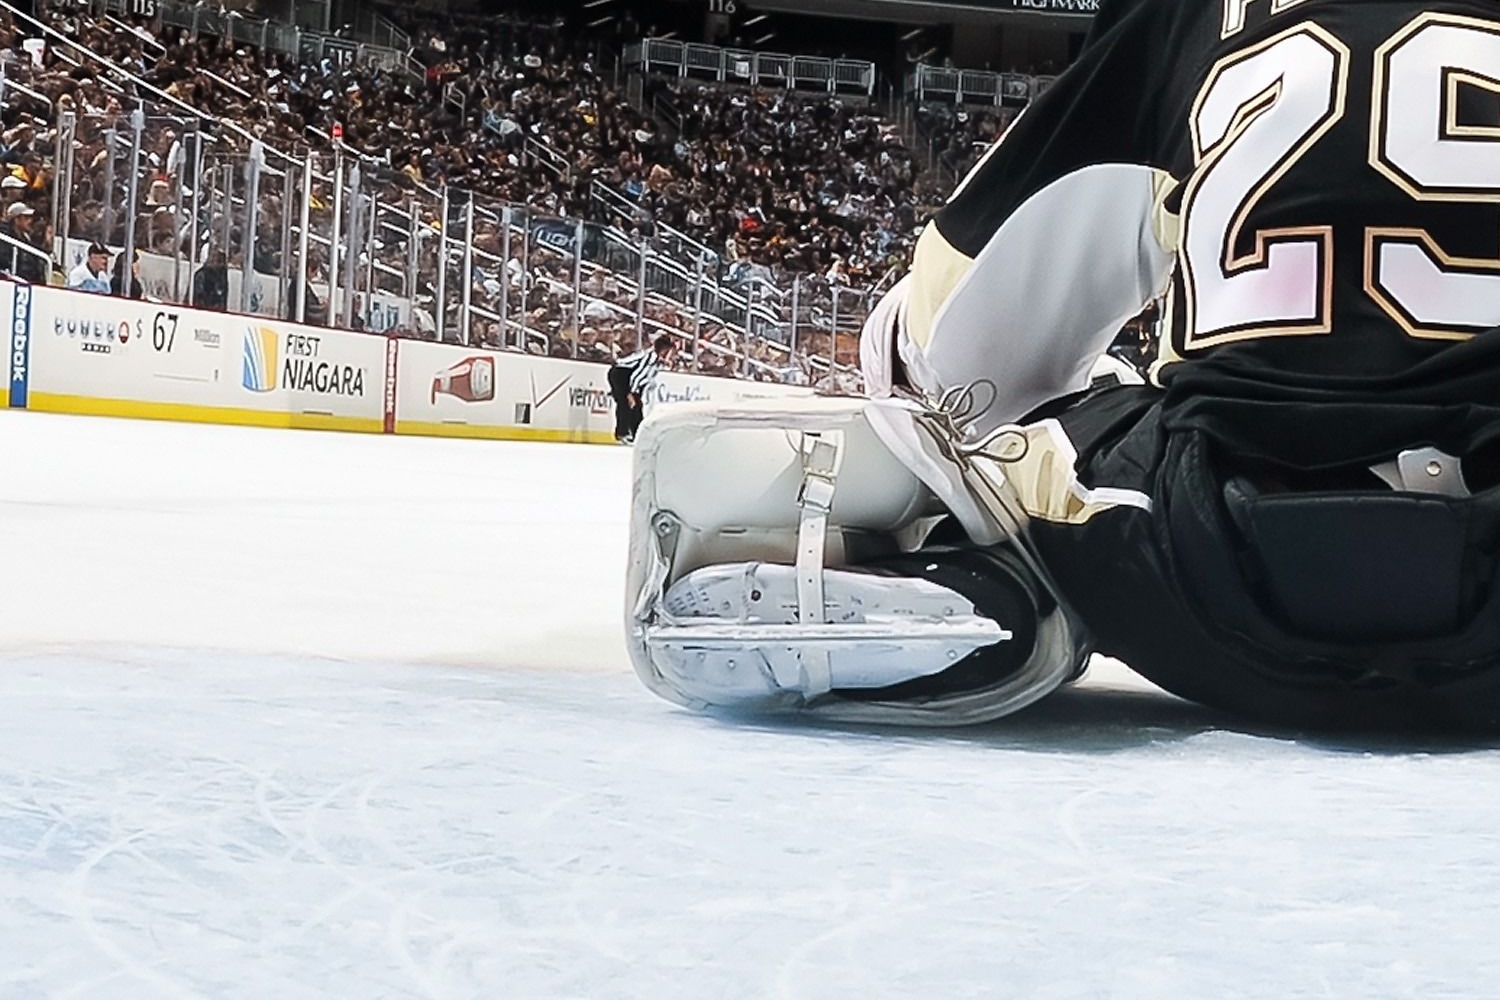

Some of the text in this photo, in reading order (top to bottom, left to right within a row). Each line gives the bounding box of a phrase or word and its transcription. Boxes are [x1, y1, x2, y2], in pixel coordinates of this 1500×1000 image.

[13, 286, 30, 382] Reebok
[152, 311, 179, 353] 67
[284, 333, 321, 357] FIRST
[282, 358, 365, 397] NIAGARA
